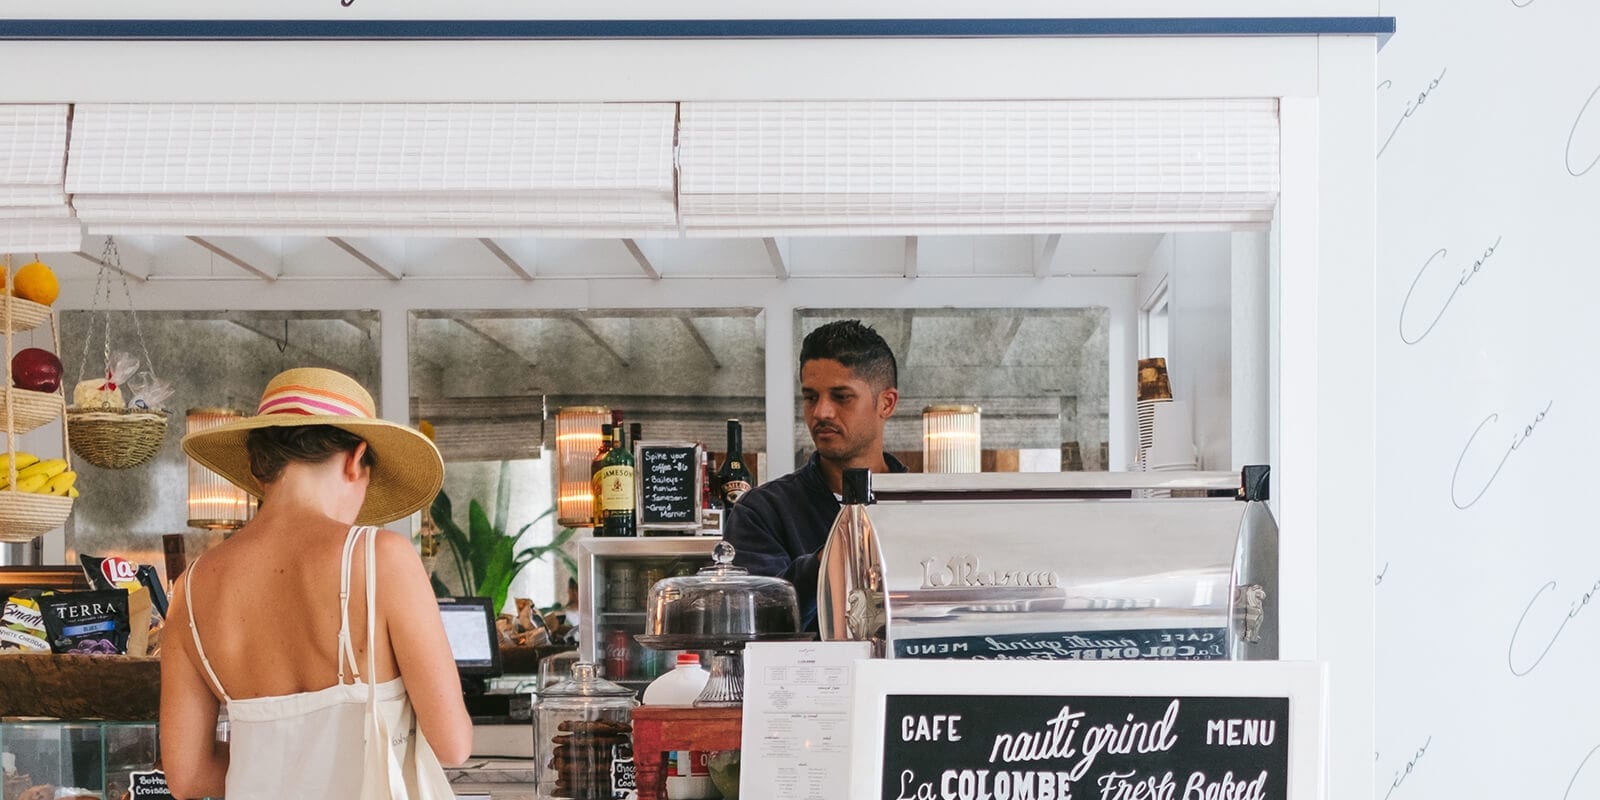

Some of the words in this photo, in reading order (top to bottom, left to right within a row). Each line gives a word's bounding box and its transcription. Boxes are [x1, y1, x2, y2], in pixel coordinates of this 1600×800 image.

[1399, 235, 1502, 345] Ciao
[670, 453, 687, 463] your
[1451, 399, 1553, 510] Ciao
[651, 475, 678, 485] Baileys
[57, 603, 116, 619] TERRA
[901, 715, 962, 741] CAFE
[988, 705, 1086, 763] nauti
[1070, 699, 1180, 782] grind
[1206, 719, 1276, 747] MENU
[896, 769, 937, 800] La
[940, 769, 1074, 800] COLOMBE
[1097, 769, 1176, 800] Fresh
[1183, 770, 1268, 800] Baked
[1375, 734, 1431, 800] iao
